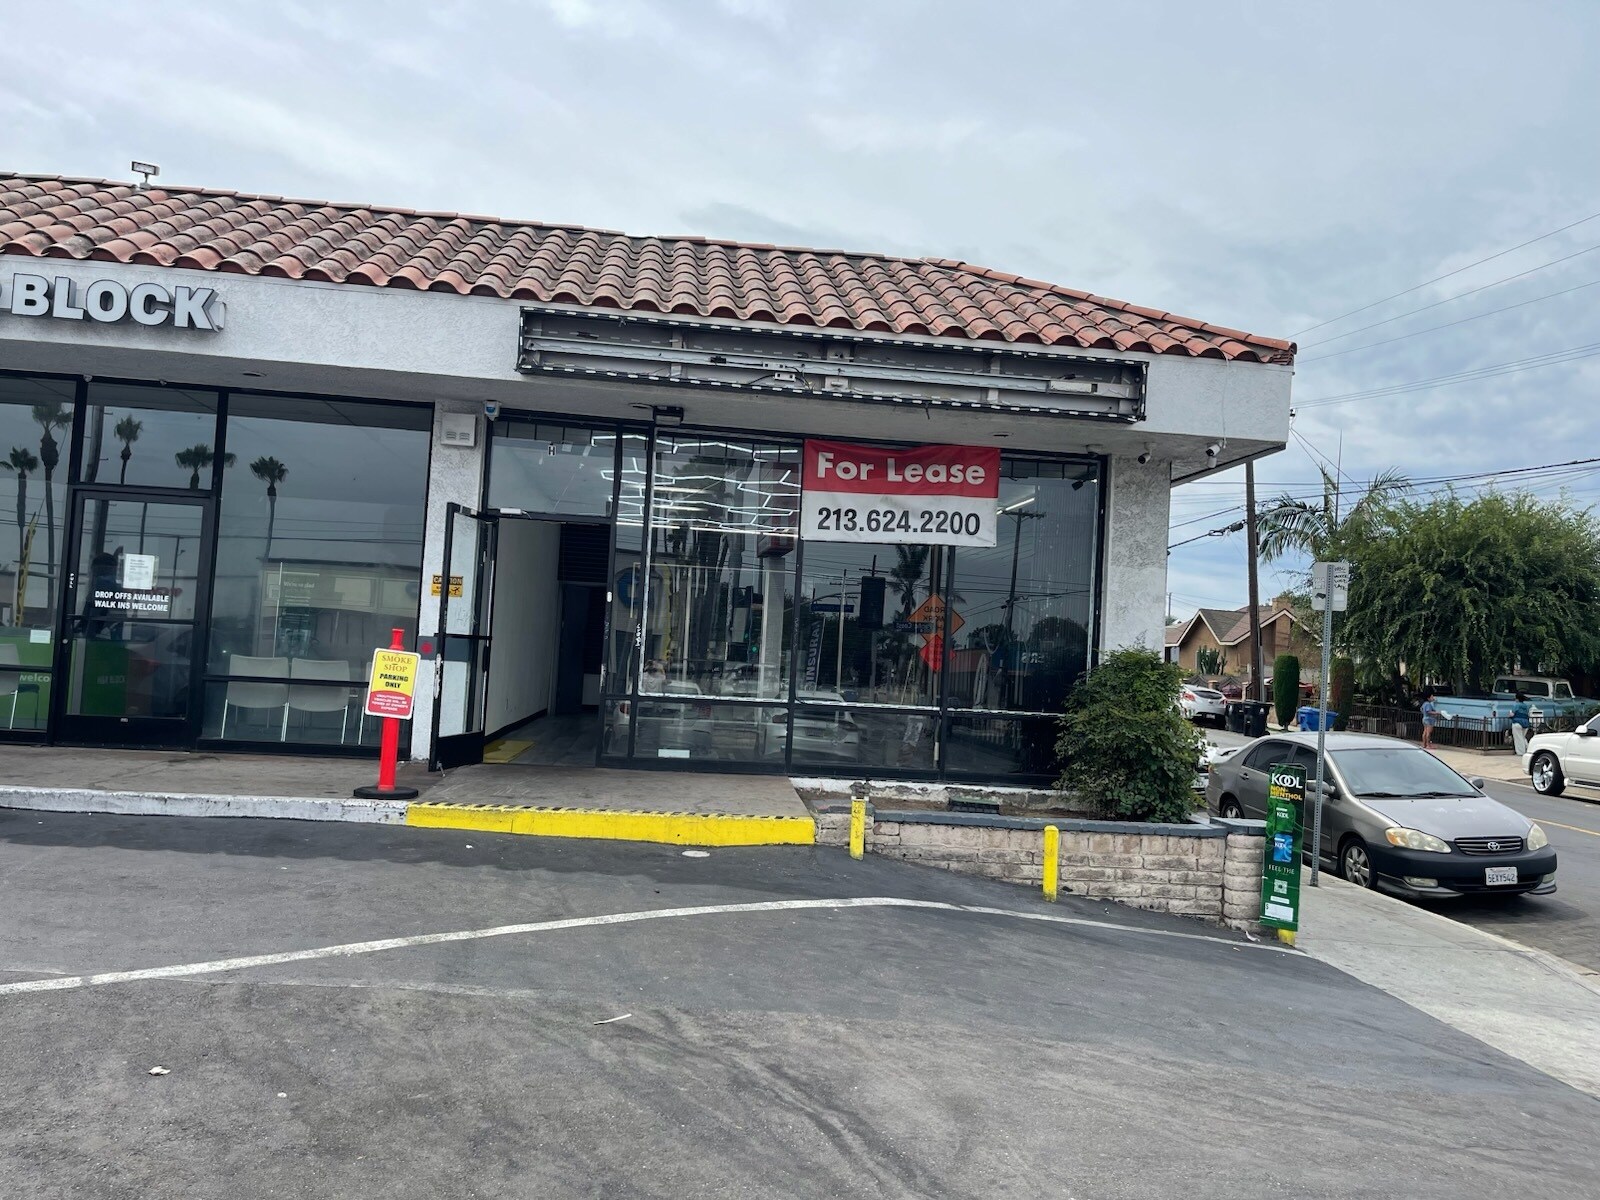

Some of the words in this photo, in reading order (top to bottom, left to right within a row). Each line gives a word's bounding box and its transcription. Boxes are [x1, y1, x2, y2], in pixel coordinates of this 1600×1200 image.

[11, 273, 219, 332] BLOCK
[817, 452, 874, 480] For
[887, 457, 986, 486] Lease
[817, 507, 981, 536] 213.624.2200
[434, 576, 462, 584] CAION
[95, 590, 113, 599] DROP
[114, 592, 132, 600] OFFS
[132, 594, 169, 603] AVAILABLE
[94, 600, 116, 609] WALK
[117, 601, 131, 610] INS
[131, 602, 168, 612] WELCOME
[382, 655, 412, 665] SMOKE
[384, 664, 408, 673] SHOP
[379, 673, 409, 682] PARKING
[385, 681, 401, 689] ONLY
[1271, 773, 1303, 789] KOOL
[1270, 791, 1303, 801] MENTHOL
[1276, 811, 1289, 819] KOOL
